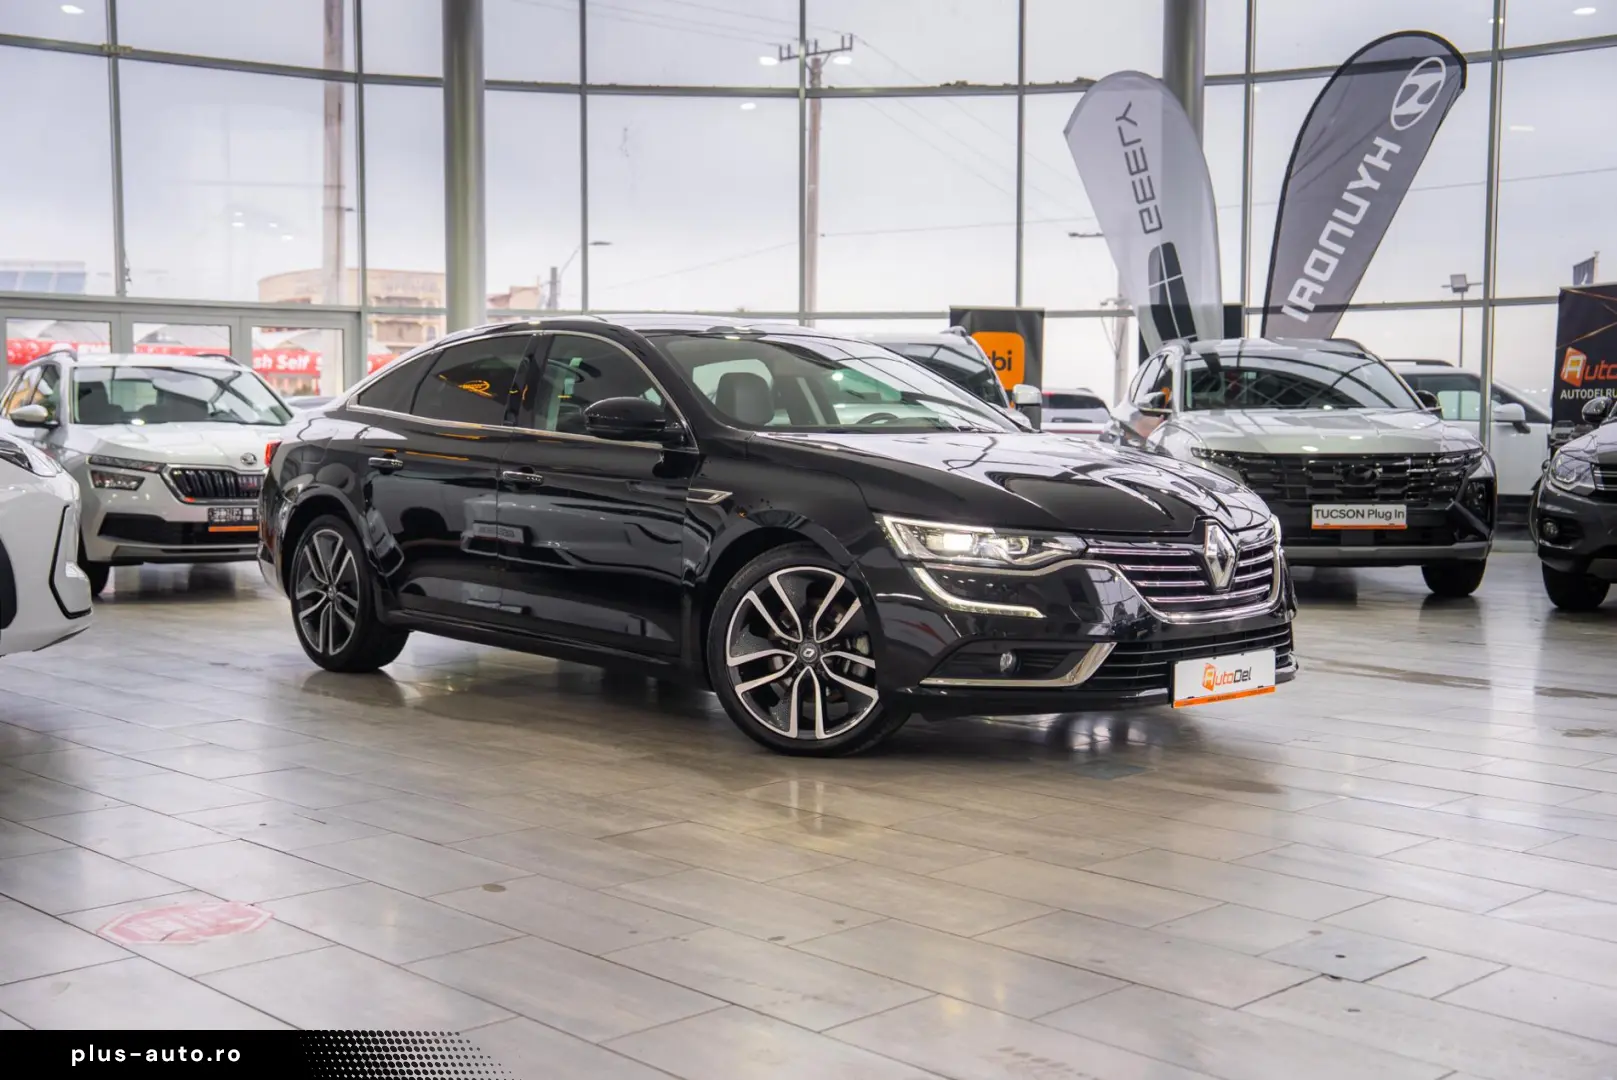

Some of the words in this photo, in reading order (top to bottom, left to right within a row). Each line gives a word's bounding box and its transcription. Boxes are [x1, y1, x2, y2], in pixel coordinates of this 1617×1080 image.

[275, 353, 311, 371] Self
[988, 350, 1012, 371] bi
[1314, 508, 1365, 519] TUCSON
[1367, 508, 1392, 521] Plug
[1394, 508, 1405, 519] In
[1203, 664, 1252, 690] AutoDel
